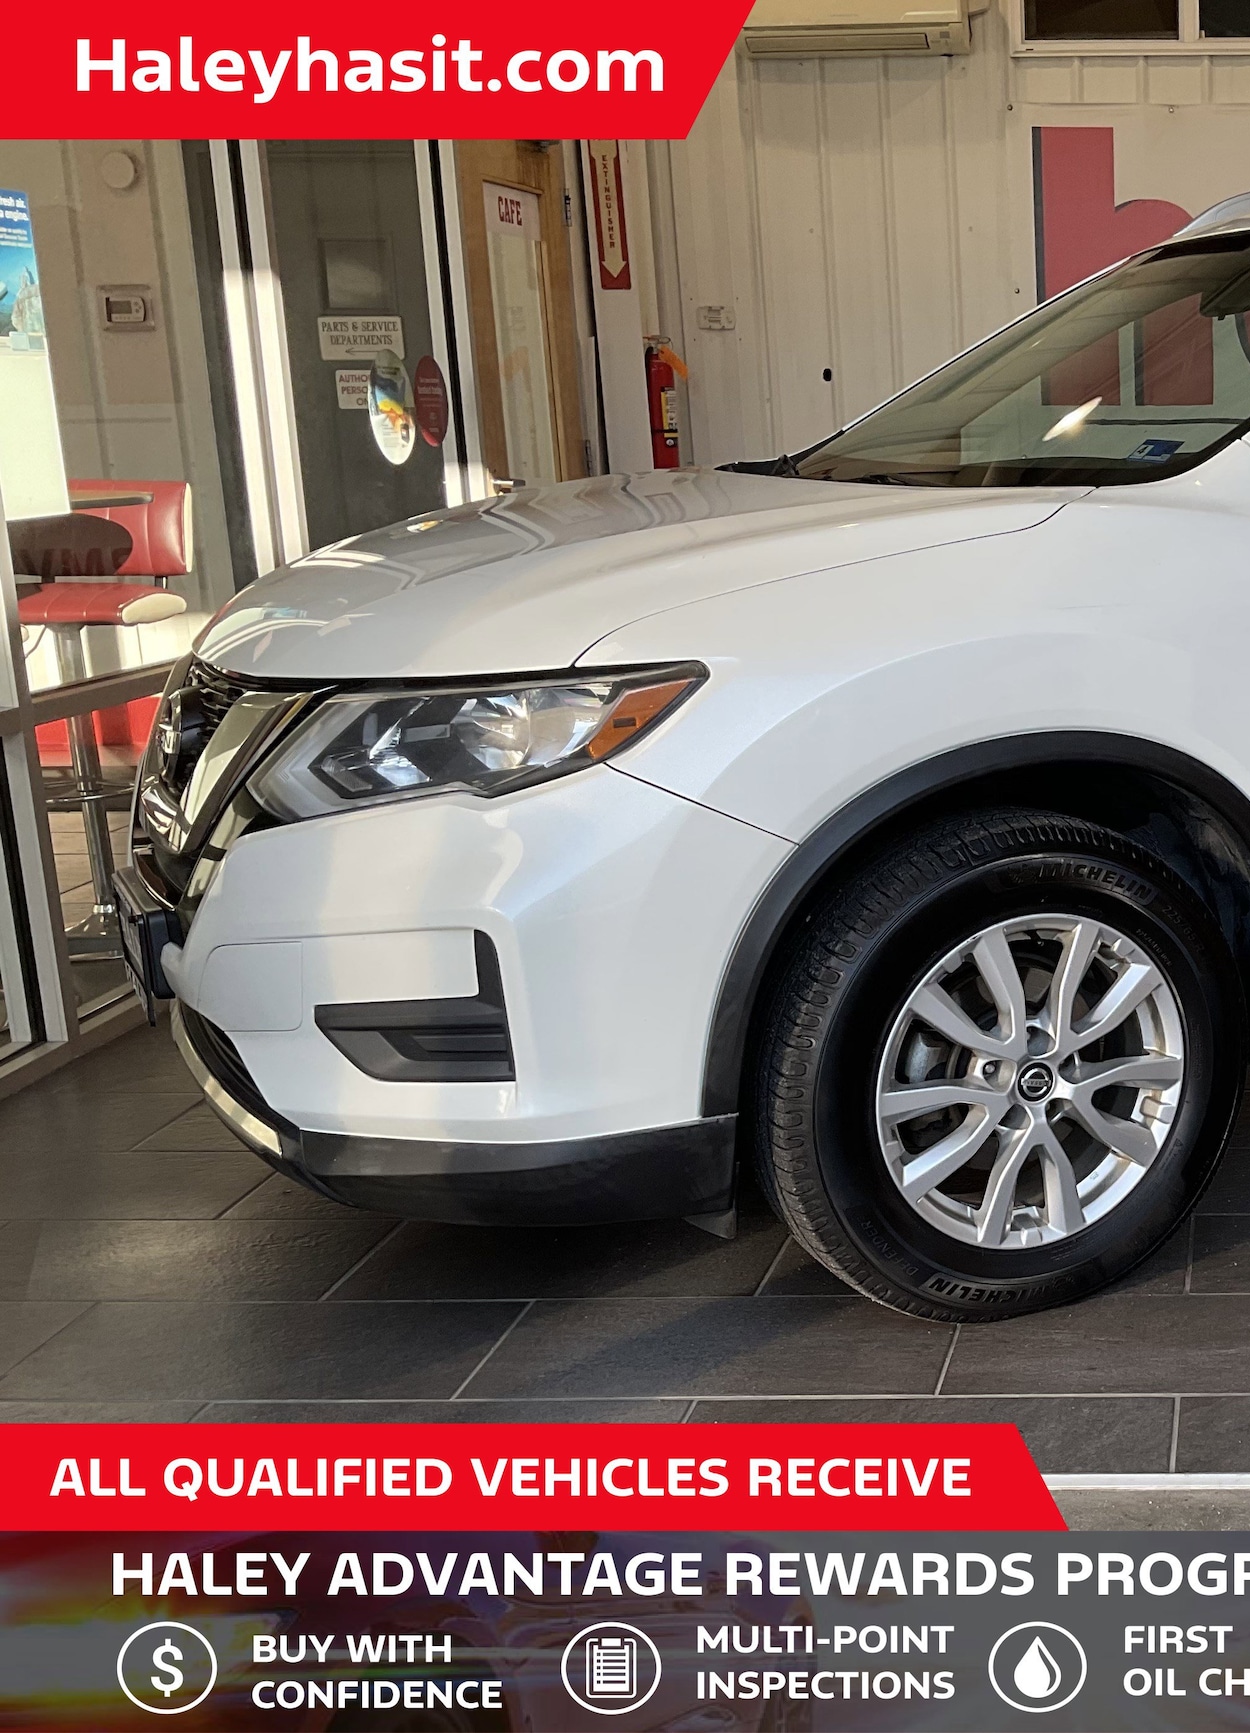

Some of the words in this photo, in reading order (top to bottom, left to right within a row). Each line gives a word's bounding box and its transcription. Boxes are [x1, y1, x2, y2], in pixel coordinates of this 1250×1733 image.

[601, 154, 615, 248] EXTINGUISHER
[498, 196, 523, 226] CAFE
[321, 322, 349, 332] PARTS
[352, 323, 358, 331] &
[362, 322, 398, 332] SERVICE
[330, 334, 393, 346] DEPARTMENTS
[338, 374, 371, 384] AUTHO
[342, 386, 368, 394] PERSO
[1038, 862, 1153, 900] MICHELIN
[928, 1277, 1047, 1304] MICHELIN
